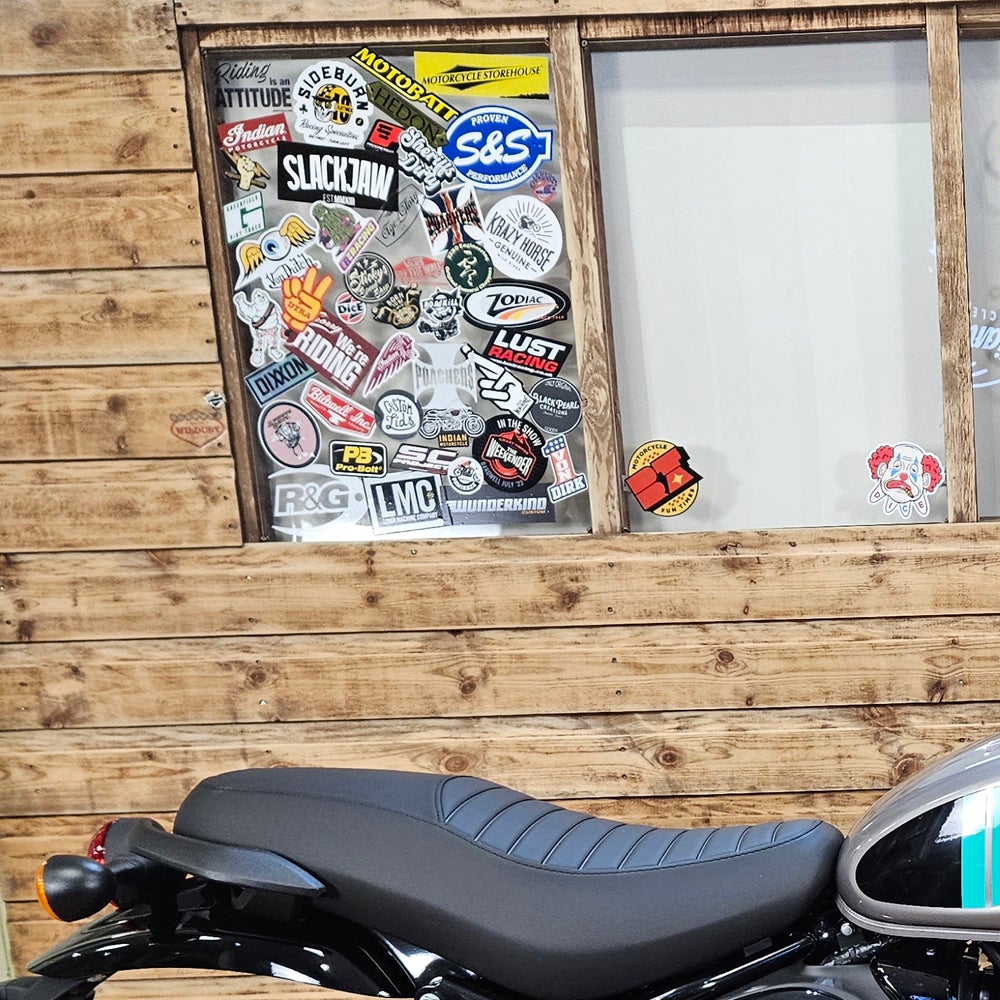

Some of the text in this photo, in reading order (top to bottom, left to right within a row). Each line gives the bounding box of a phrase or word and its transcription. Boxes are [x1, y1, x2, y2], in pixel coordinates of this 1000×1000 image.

[214, 62, 271, 84] Riding
[269, 77, 290, 86] is an
[355, 48, 458, 121] MOTOBATT
[422, 66, 541, 86] MOTORCYCLE STOREHOUSE
[215, 87, 292, 107] ATTITUDE
[298, 66, 369, 110] SIDEBURN
[374, 87, 439, 141] HEDON
[471, 114, 509, 126] PROVEN
[222, 123, 285, 147] Indian
[227, 135, 287, 153] MOTORCYCLE
[454, 128, 532, 167] S&S
[283, 154, 395, 202] SLACKJAW
[466, 164, 528, 183] PERFORMANCE
[486, 211, 523, 246] KRAZY
[519, 237, 555, 272] HORSE
[494, 241, 531, 270] GENUINE
[486, 293, 543, 318] ZODIAC
[294, 326, 363, 388] RIDING
[336, 332, 370, 367] We're
[493, 329, 567, 360] LUST
[488, 345, 559, 374] RACING
[254, 357, 309, 397] DIXXON
[307, 386, 353, 418] Biltwell
[439, 433, 467, 442] INDIAN
[496, 419, 507, 429] IN
[507, 418, 522, 430] THE
[522, 424, 542, 447] SHOW
[342, 445, 373, 464] PB
[485, 438, 533, 477] WEEKENDER
[552, 448, 572, 481] VON
[631, 443, 668, 470] MOTORCYCLE
[277, 484, 350, 513] R&G
[375, 479, 436, 518] LMC
[549, 476, 586, 501] DIRK
[678, 488, 695, 509] TIMES
